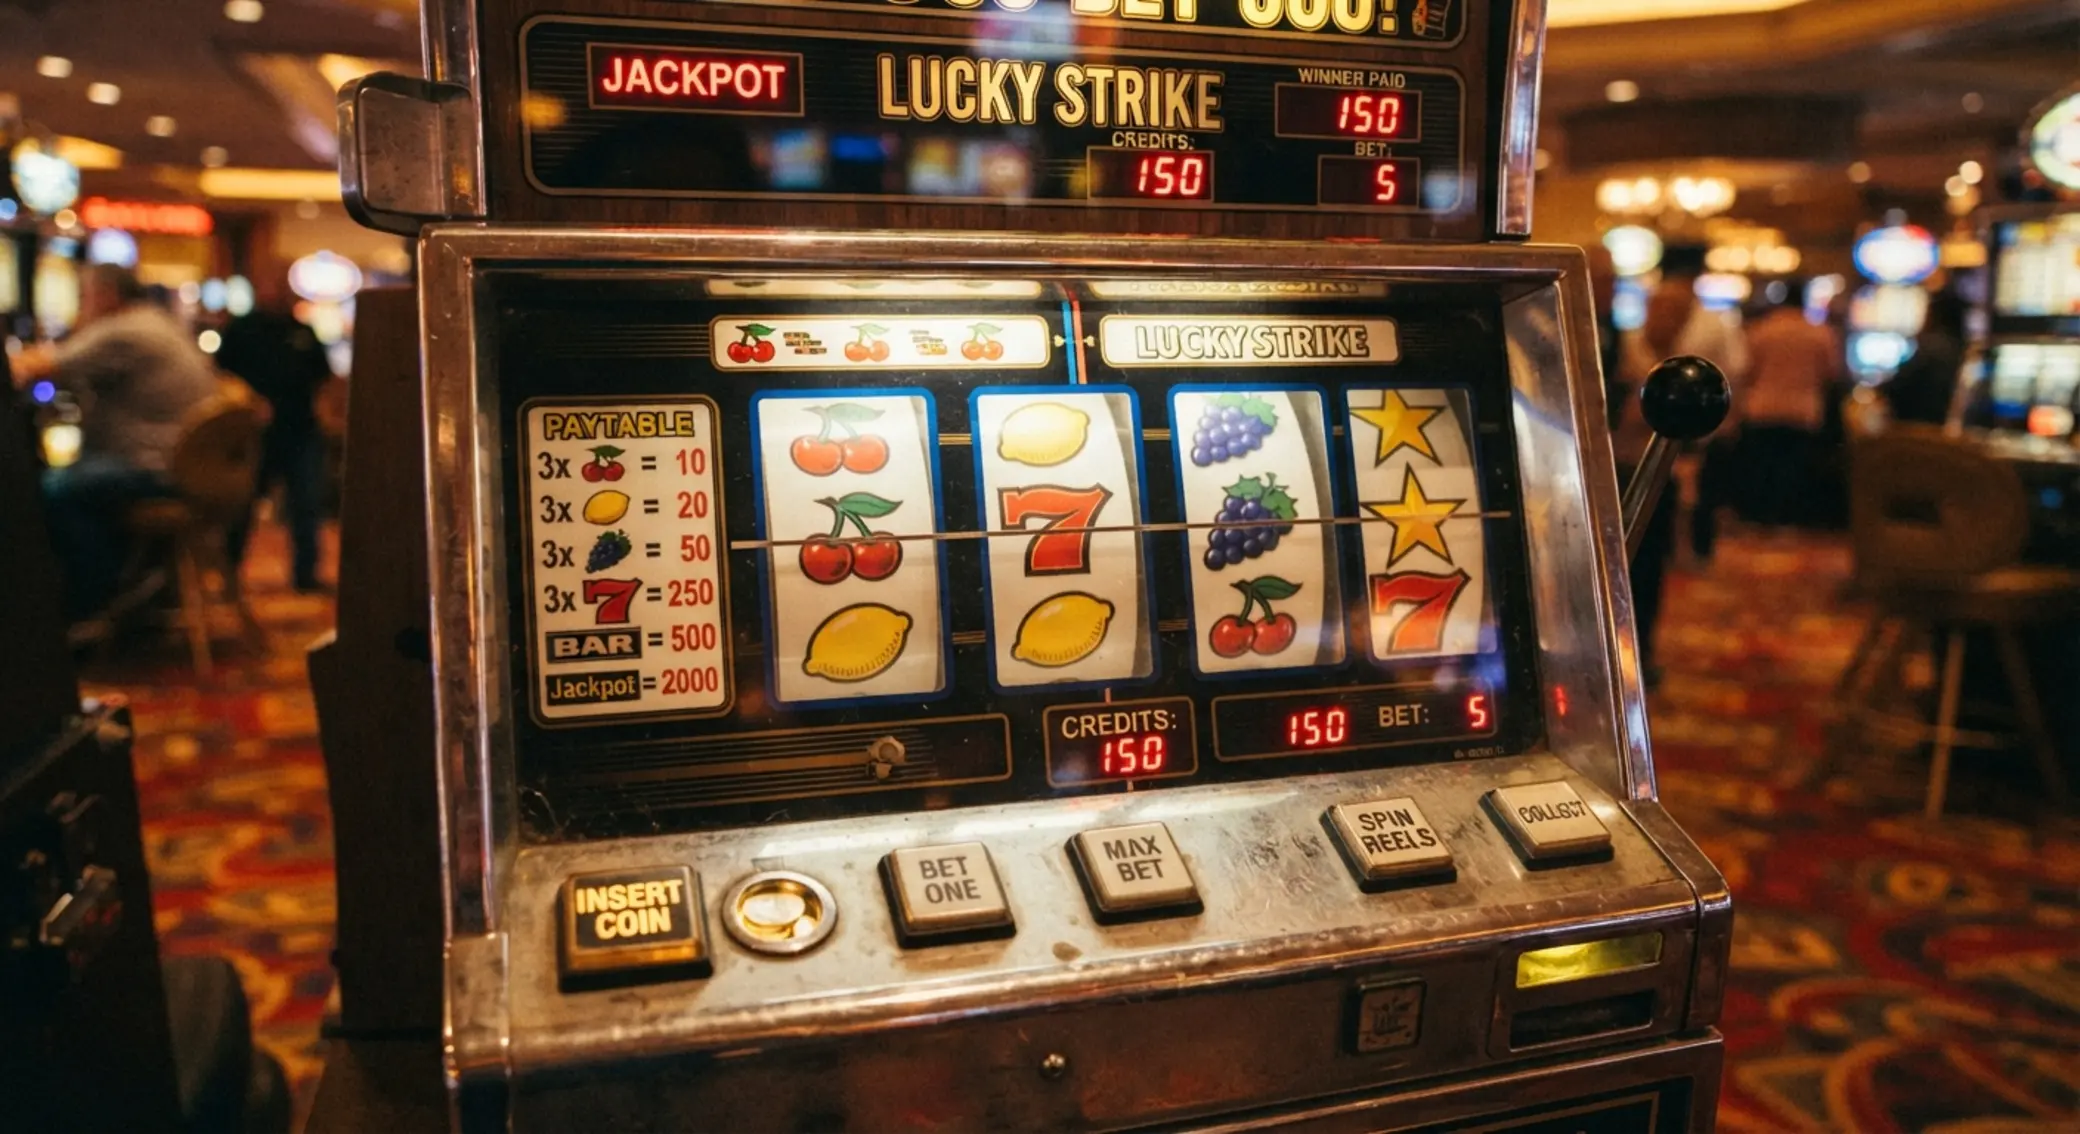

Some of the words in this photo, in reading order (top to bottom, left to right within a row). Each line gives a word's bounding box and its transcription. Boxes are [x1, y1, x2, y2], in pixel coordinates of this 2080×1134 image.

[603, 58, 785, 99] JACKPOT
[878, 53, 1046, 124] LUCKY
[1054, 63, 1225, 132] STRIKE
[1298, 67, 1364, 86] WINNER
[1369, 71, 1406, 88] PAID
[1339, 95, 1399, 133] 150
[1138, 157, 1203, 195] 150
[1376, 164, 1395, 201] 5
[1135, 325, 1251, 360] LUCKY
[1251, 325, 1370, 359] STRIKE
[543, 411, 695, 440] PAYTABLE
[537, 451, 572, 480] 3x
[676, 448, 706, 475] 10
[540, 495, 573, 524] 3x
[677, 491, 708, 519] 20
[997, 482, 1113, 577] 7
[541, 540, 575, 568] 3x
[681, 534, 710, 562] 50
[544, 584, 577, 613] 3x
[668, 578, 714, 606] 250
[1368, 567, 1472, 655] 7
[553, 634, 634, 657] BAR
[671, 623, 716, 652] 500
[551, 675, 636, 700] Jackpot
[661, 667, 718, 695] 2000
[1061, 709, 1177, 738] CREDITS:
[1289, 711, 1345, 745] 150
[1378, 704, 1430, 728] BET:
[1468, 696, 1487, 729] 5
[1104, 736, 1162, 773] 150
[1358, 808, 1415, 831] SPIN
[1102, 835, 1162, 861] MAX
[1361, 828, 1437, 855] REELS
[919, 856, 968, 880] BET
[1116, 858, 1164, 882] BET
[575, 879, 683, 914] INSERT
[925, 879, 981, 904] ONE
[595, 907, 672, 939] COIN
